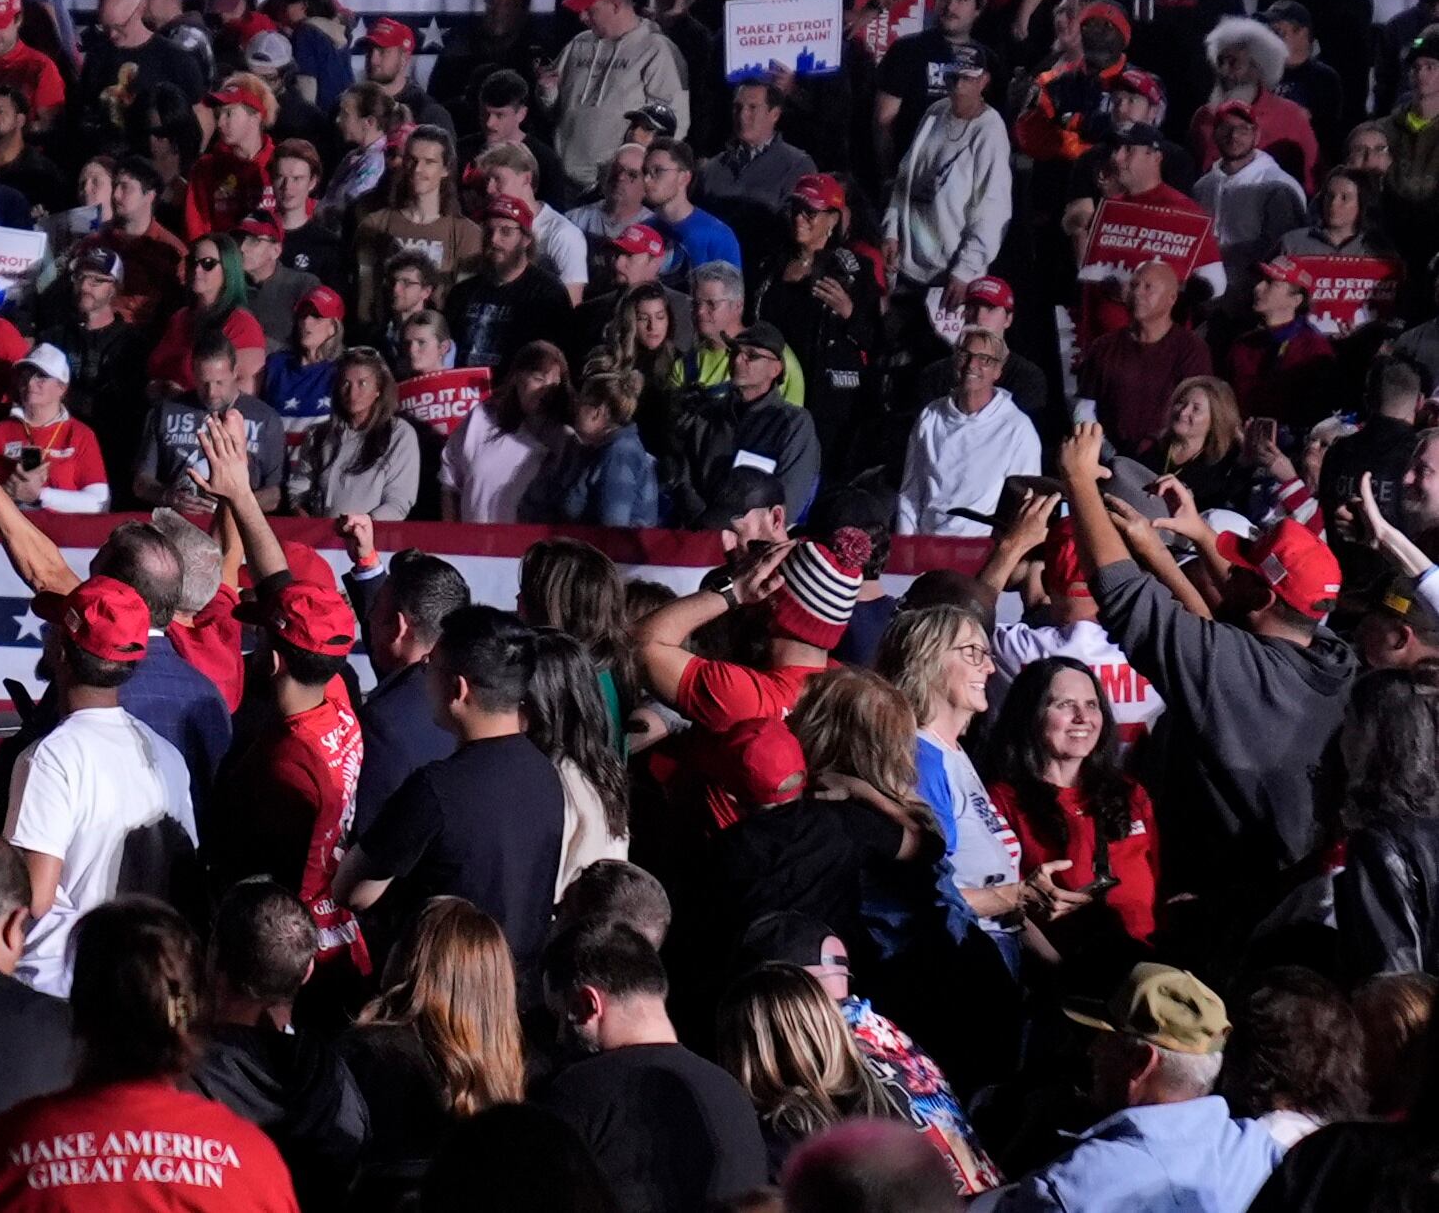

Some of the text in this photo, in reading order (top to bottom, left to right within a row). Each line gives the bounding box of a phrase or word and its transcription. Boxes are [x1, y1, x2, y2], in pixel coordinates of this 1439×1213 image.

[736, 18, 833, 36] MAKE DETROIT
[739, 30, 831, 47] GREAT AGAIN!
[1101, 223, 1198, 246] MAKE DETROIT
[1100, 235, 1191, 258] GREAT AGAIN!
[438, 388, 456, 402] IT
[460, 386, 480, 400] IN
[166, 412, 196, 434] US
[9, 1130, 242, 1169] MAKE AMERICA
[26, 1156, 224, 1191] GREAT AGAIN
